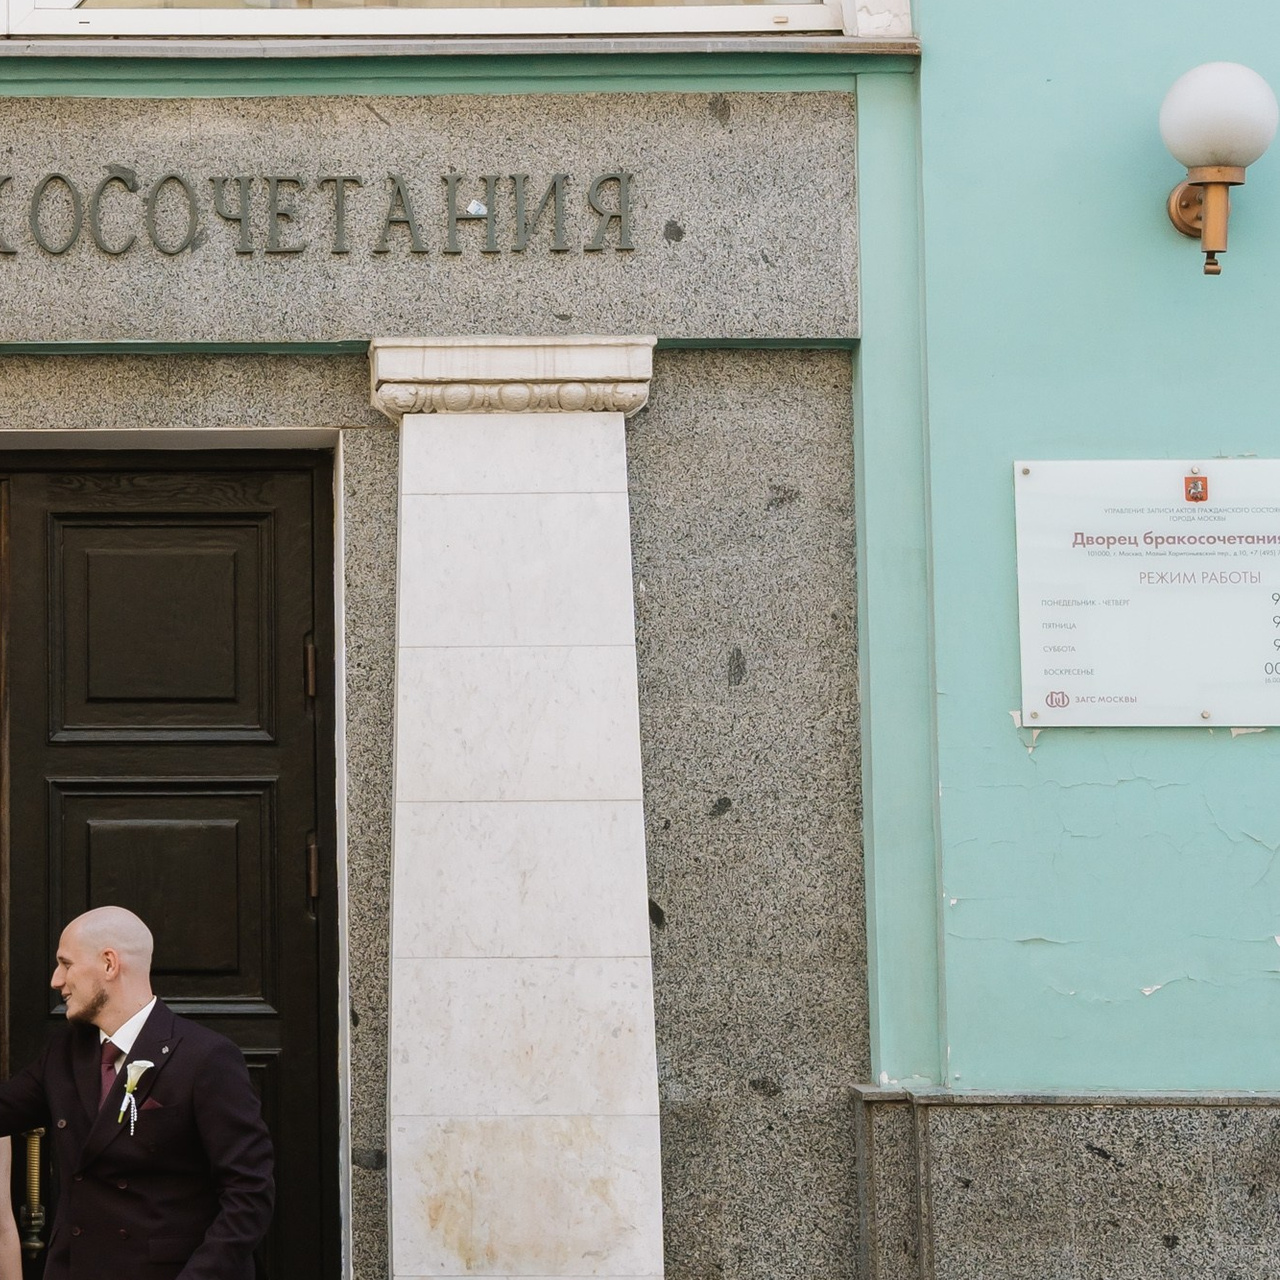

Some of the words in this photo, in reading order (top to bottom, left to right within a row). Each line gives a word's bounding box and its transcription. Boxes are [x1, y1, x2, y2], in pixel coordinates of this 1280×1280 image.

[1072, 532, 1139, 549] Дворец
[1139, 571, 1197, 584] РЕЖИМ
[1201, 571, 1261, 584] РАБОТЫ
[1041, 599, 1096, 607] ПОНЕДЕЛЬНИК
[1102, 599, 1130, 607] ЧЕТВЕРГ
[1042, 622, 1077, 630] ПЯТНИЦА
[1042, 645, 1076, 653] СУББОТА
[1043, 668, 1095, 676] ВОСКРЕСЕНЬЕ
[1075, 695, 1096, 703] ЗАГС
[1097, 695, 1137, 703] МОСКВЫ
